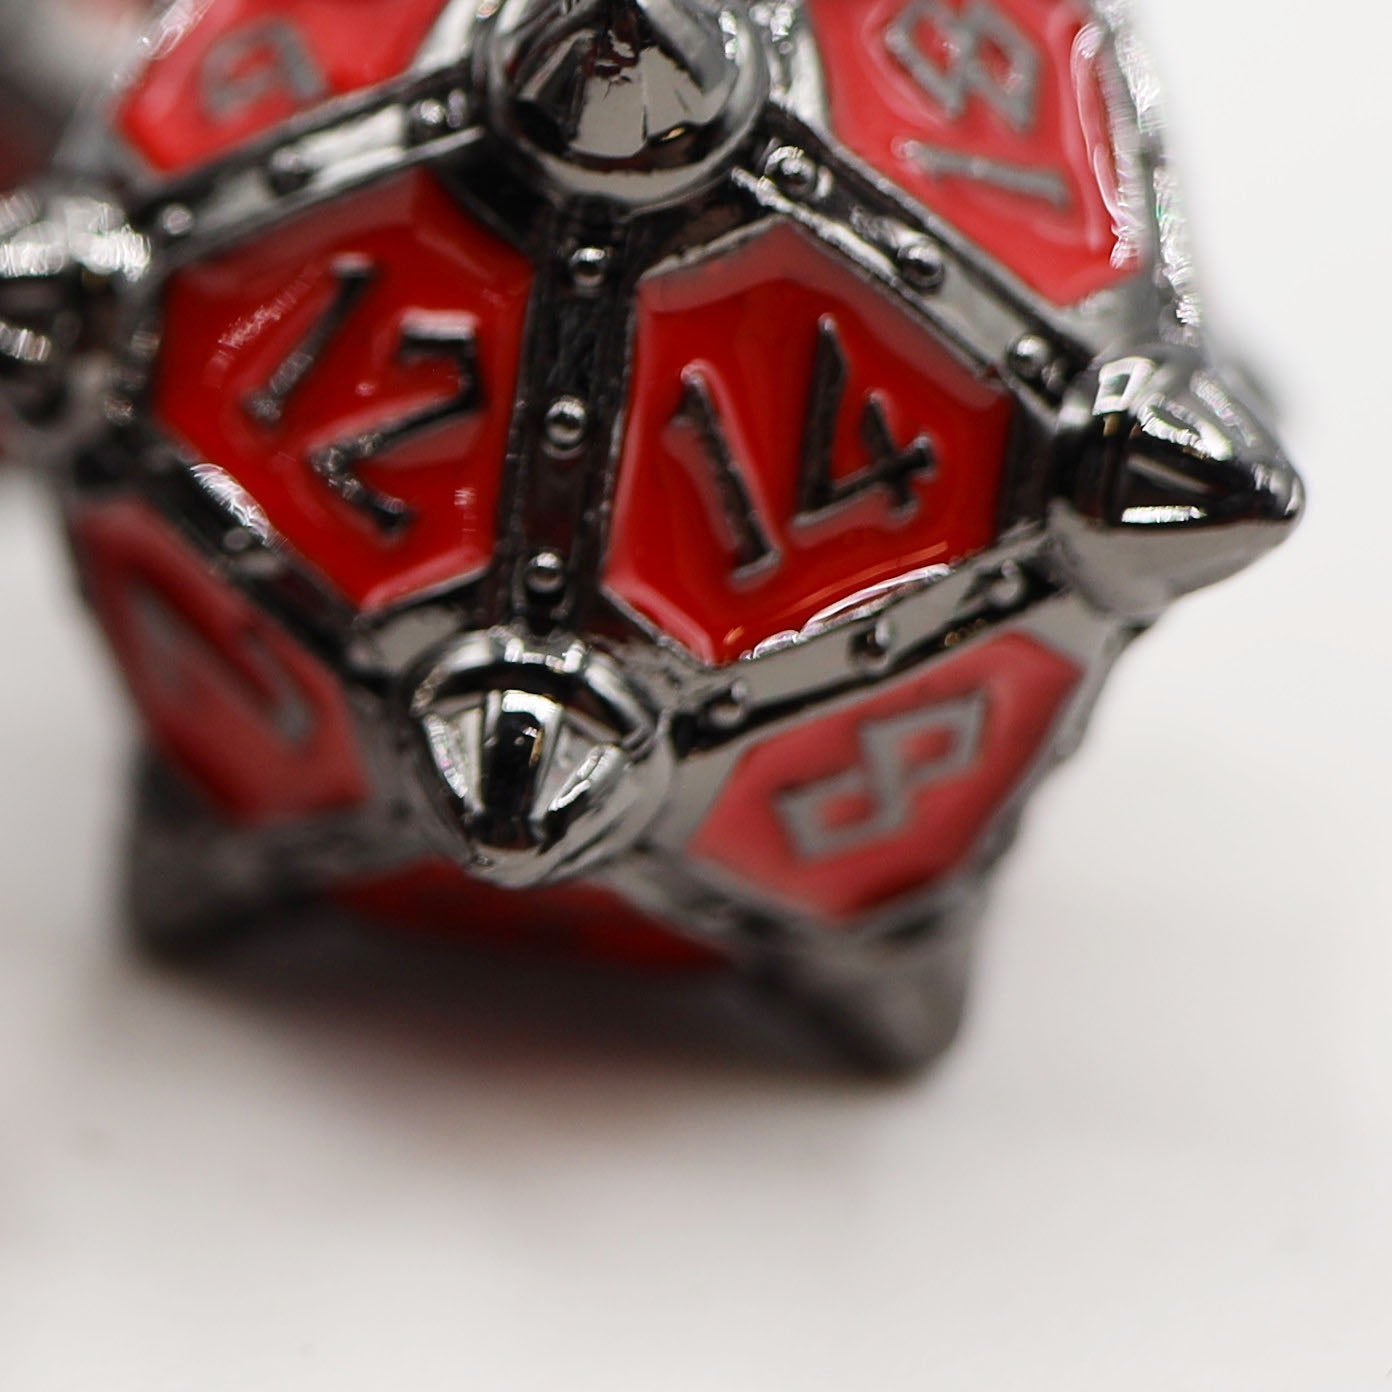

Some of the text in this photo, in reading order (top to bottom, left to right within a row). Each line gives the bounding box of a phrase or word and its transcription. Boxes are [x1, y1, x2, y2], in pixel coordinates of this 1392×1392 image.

[246, 253, 491, 533] 12
[671, 313, 933, 578] 14
[768, 688, 990, 864] 8
